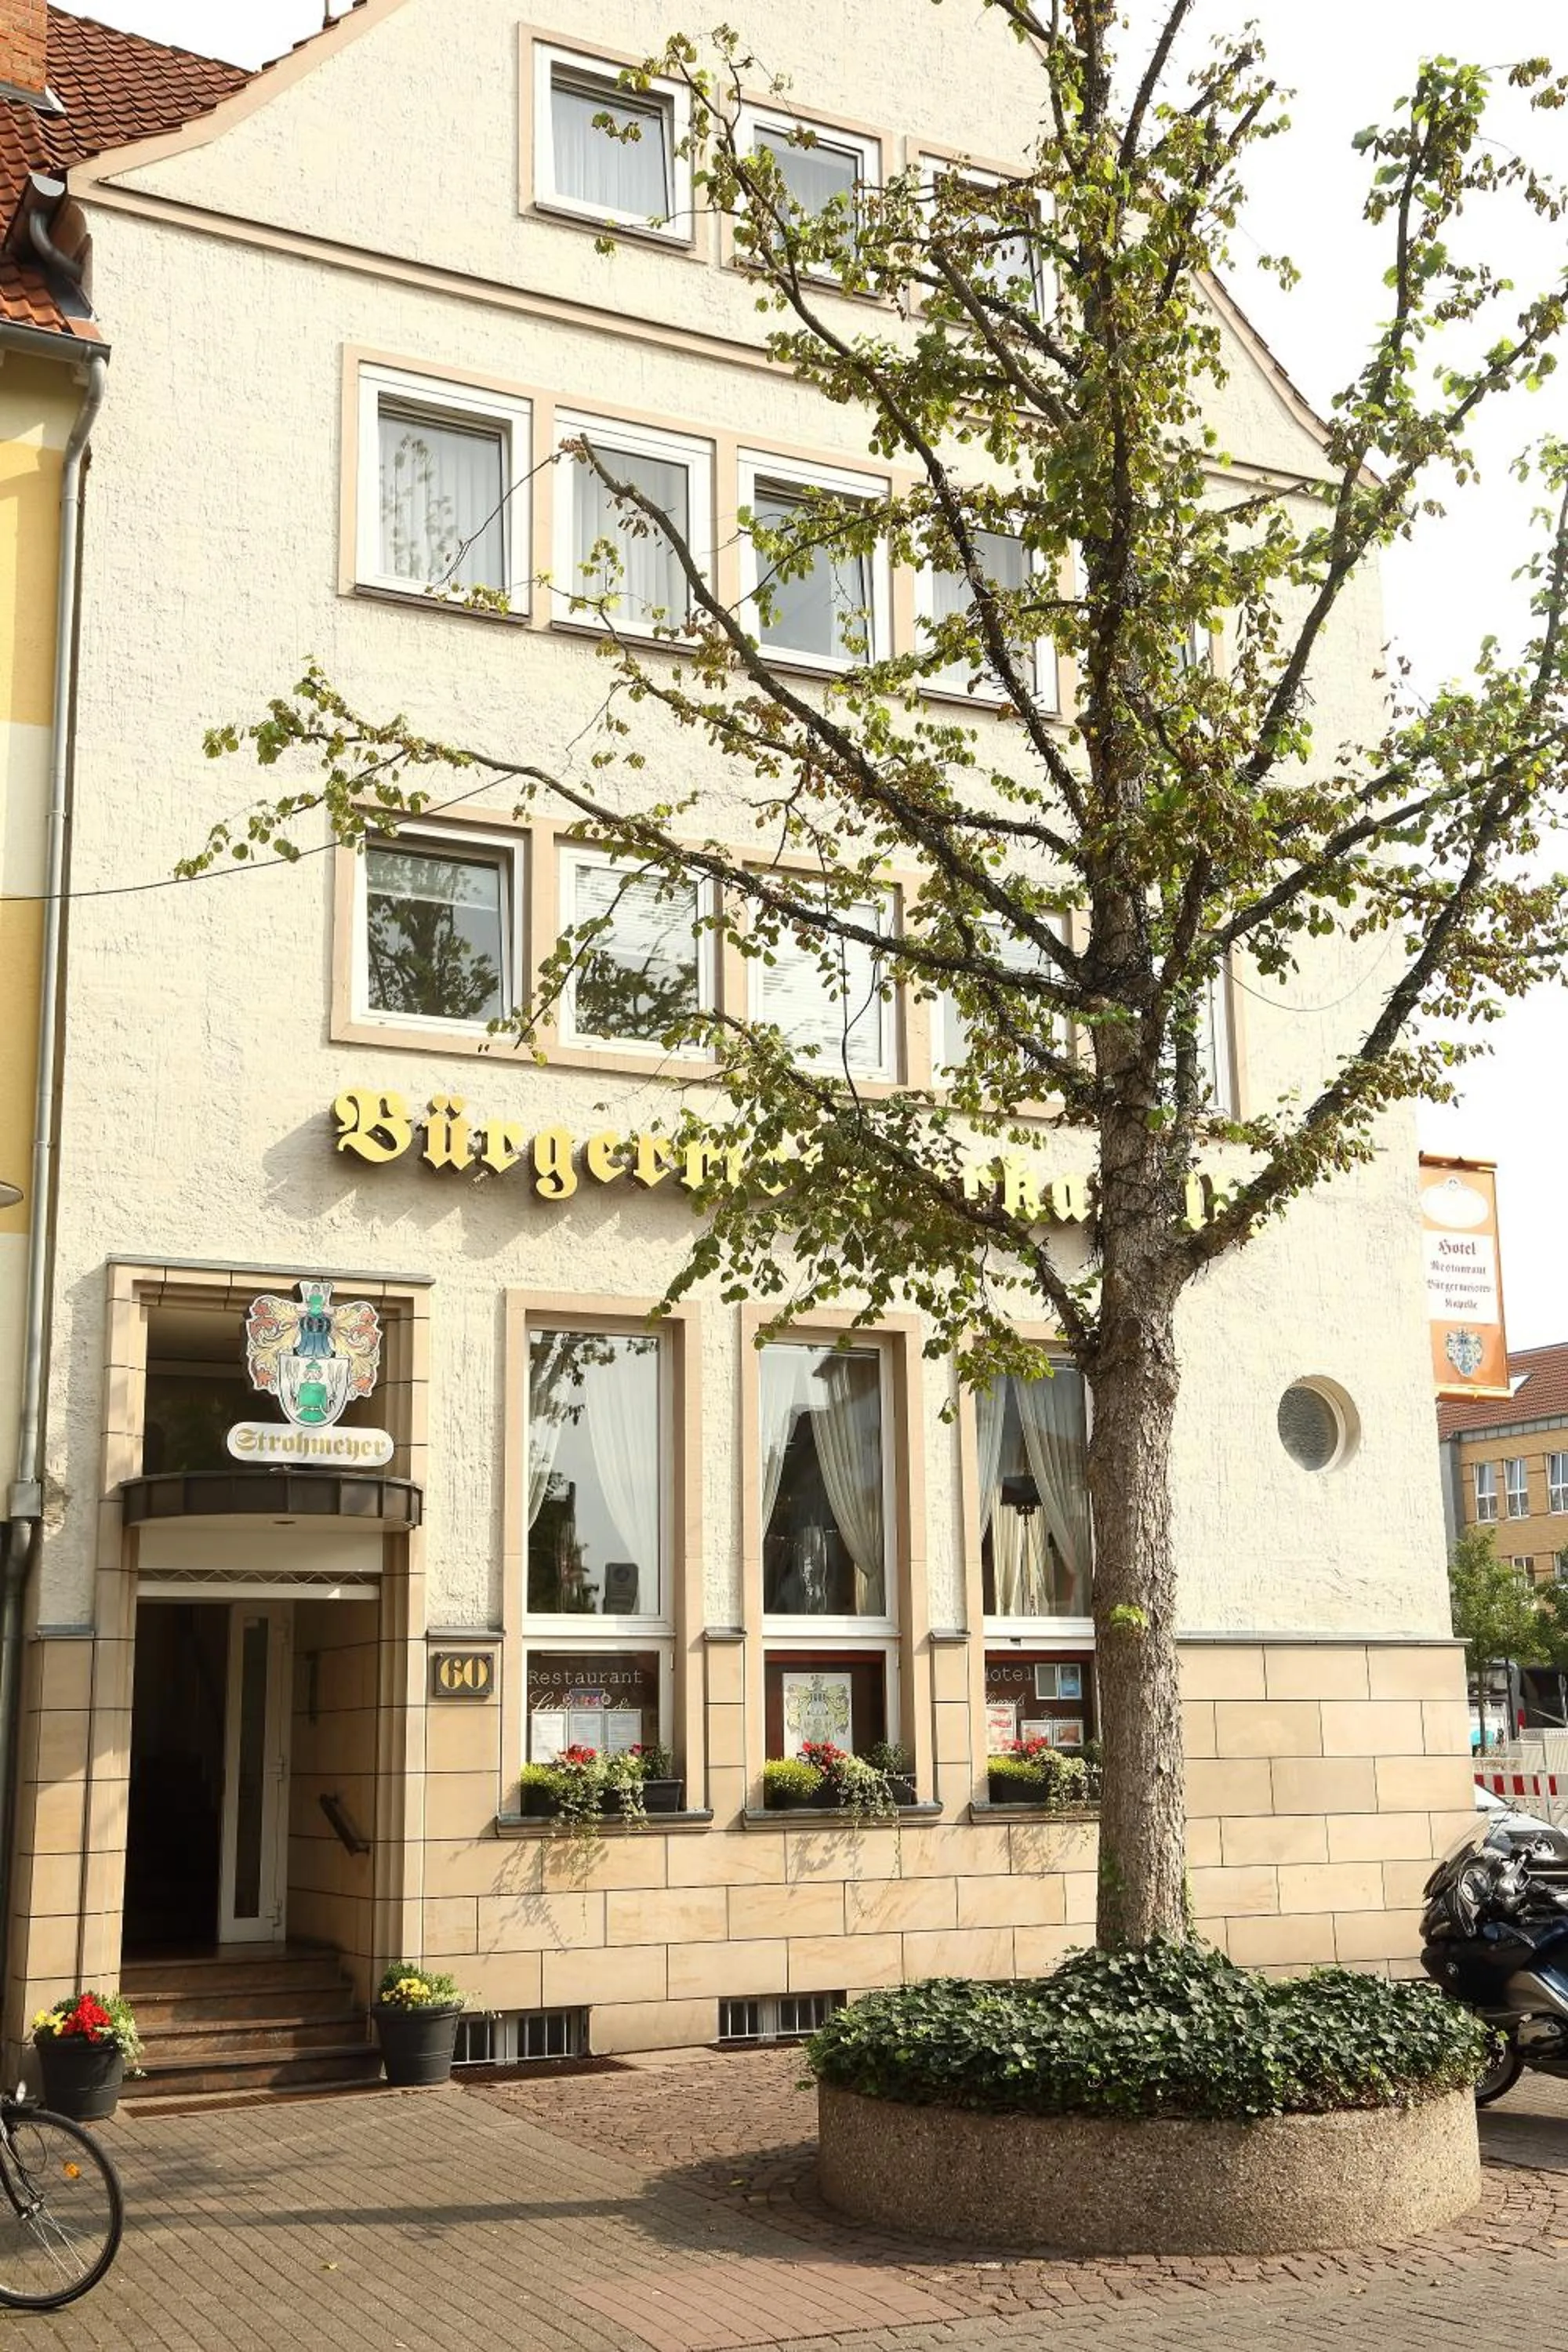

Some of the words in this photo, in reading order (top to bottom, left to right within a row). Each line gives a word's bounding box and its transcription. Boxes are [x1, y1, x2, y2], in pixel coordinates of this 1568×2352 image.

[1438, 1238, 1476, 1255] Hotel
[234, 1428, 387, 1462] Strohmeyer
[440, 1657, 488, 1689] 60
[527, 1668, 644, 1686] Restaurant
